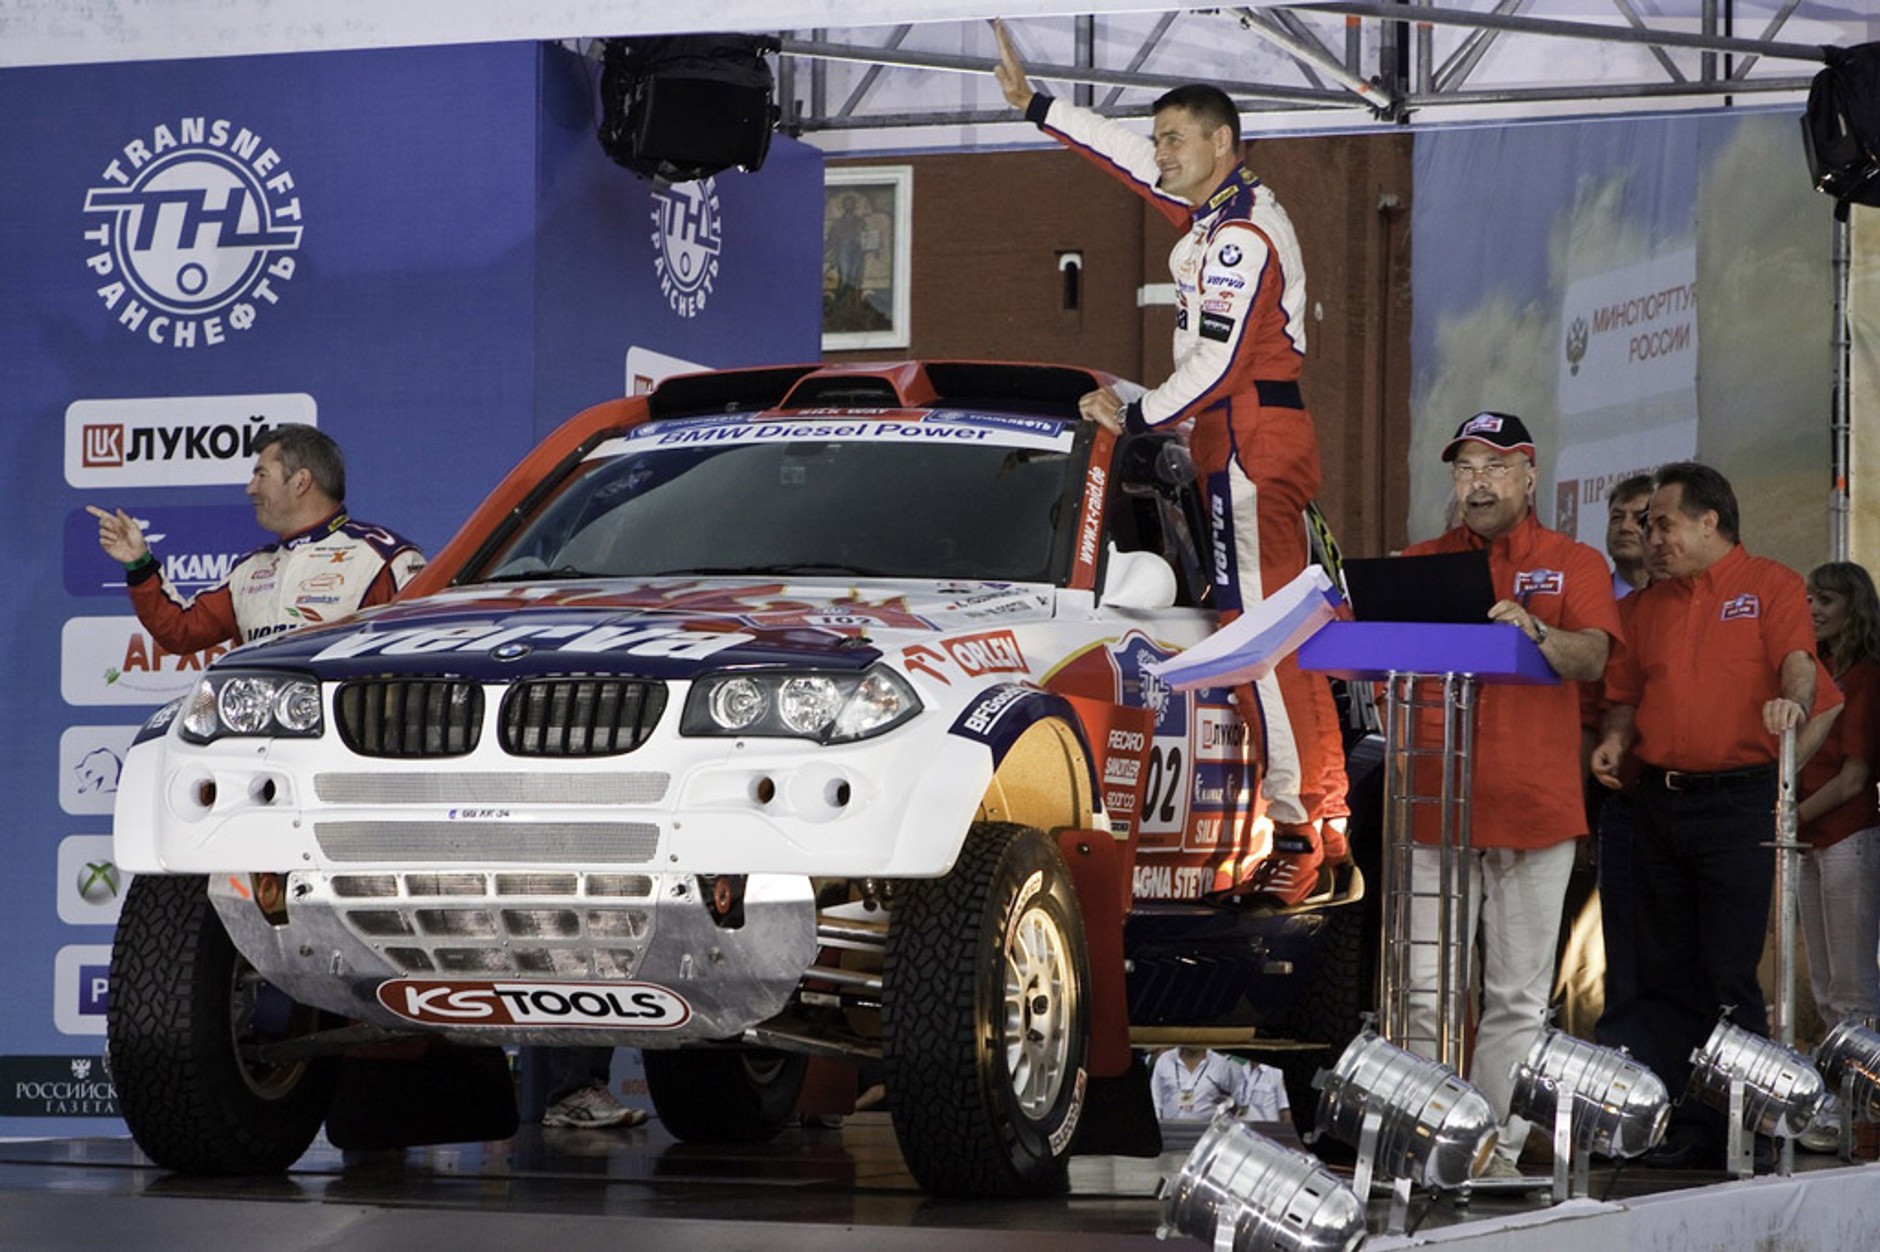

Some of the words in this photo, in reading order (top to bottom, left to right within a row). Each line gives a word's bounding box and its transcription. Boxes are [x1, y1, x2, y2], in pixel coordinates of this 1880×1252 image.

[102, 117, 302, 221] TRANSNEFT
[651, 209, 719, 318] ТРАНСНЕФТЬ
[84, 223, 297, 348] ТРАНСНЕФТЬ
[1628, 322, 1691, 364] РОССИИ
[126, 415, 292, 462] ЛУКОЙ
[657, 426, 752, 445] BMW
[753, 424, 868, 438] Diesel
[874, 423, 994, 440] Power
[1080, 465, 1106, 566] www.x-raid.de
[309, 624, 757, 662] verva
[951, 635, 1027, 672] ORLEN
[1107, 729, 1145, 752] RECARO
[1141, 744, 1182, 823] 02
[1132, 865, 1172, 899] AGNA
[1173, 866, 1215, 899] STEYR
[404, 985, 496, 1018] KS
[494, 989, 666, 1019] TOOLS
[16, 1079, 118, 1100] РОССИЙСК
[45, 1101, 115, 1114] ГАЗЕТА
